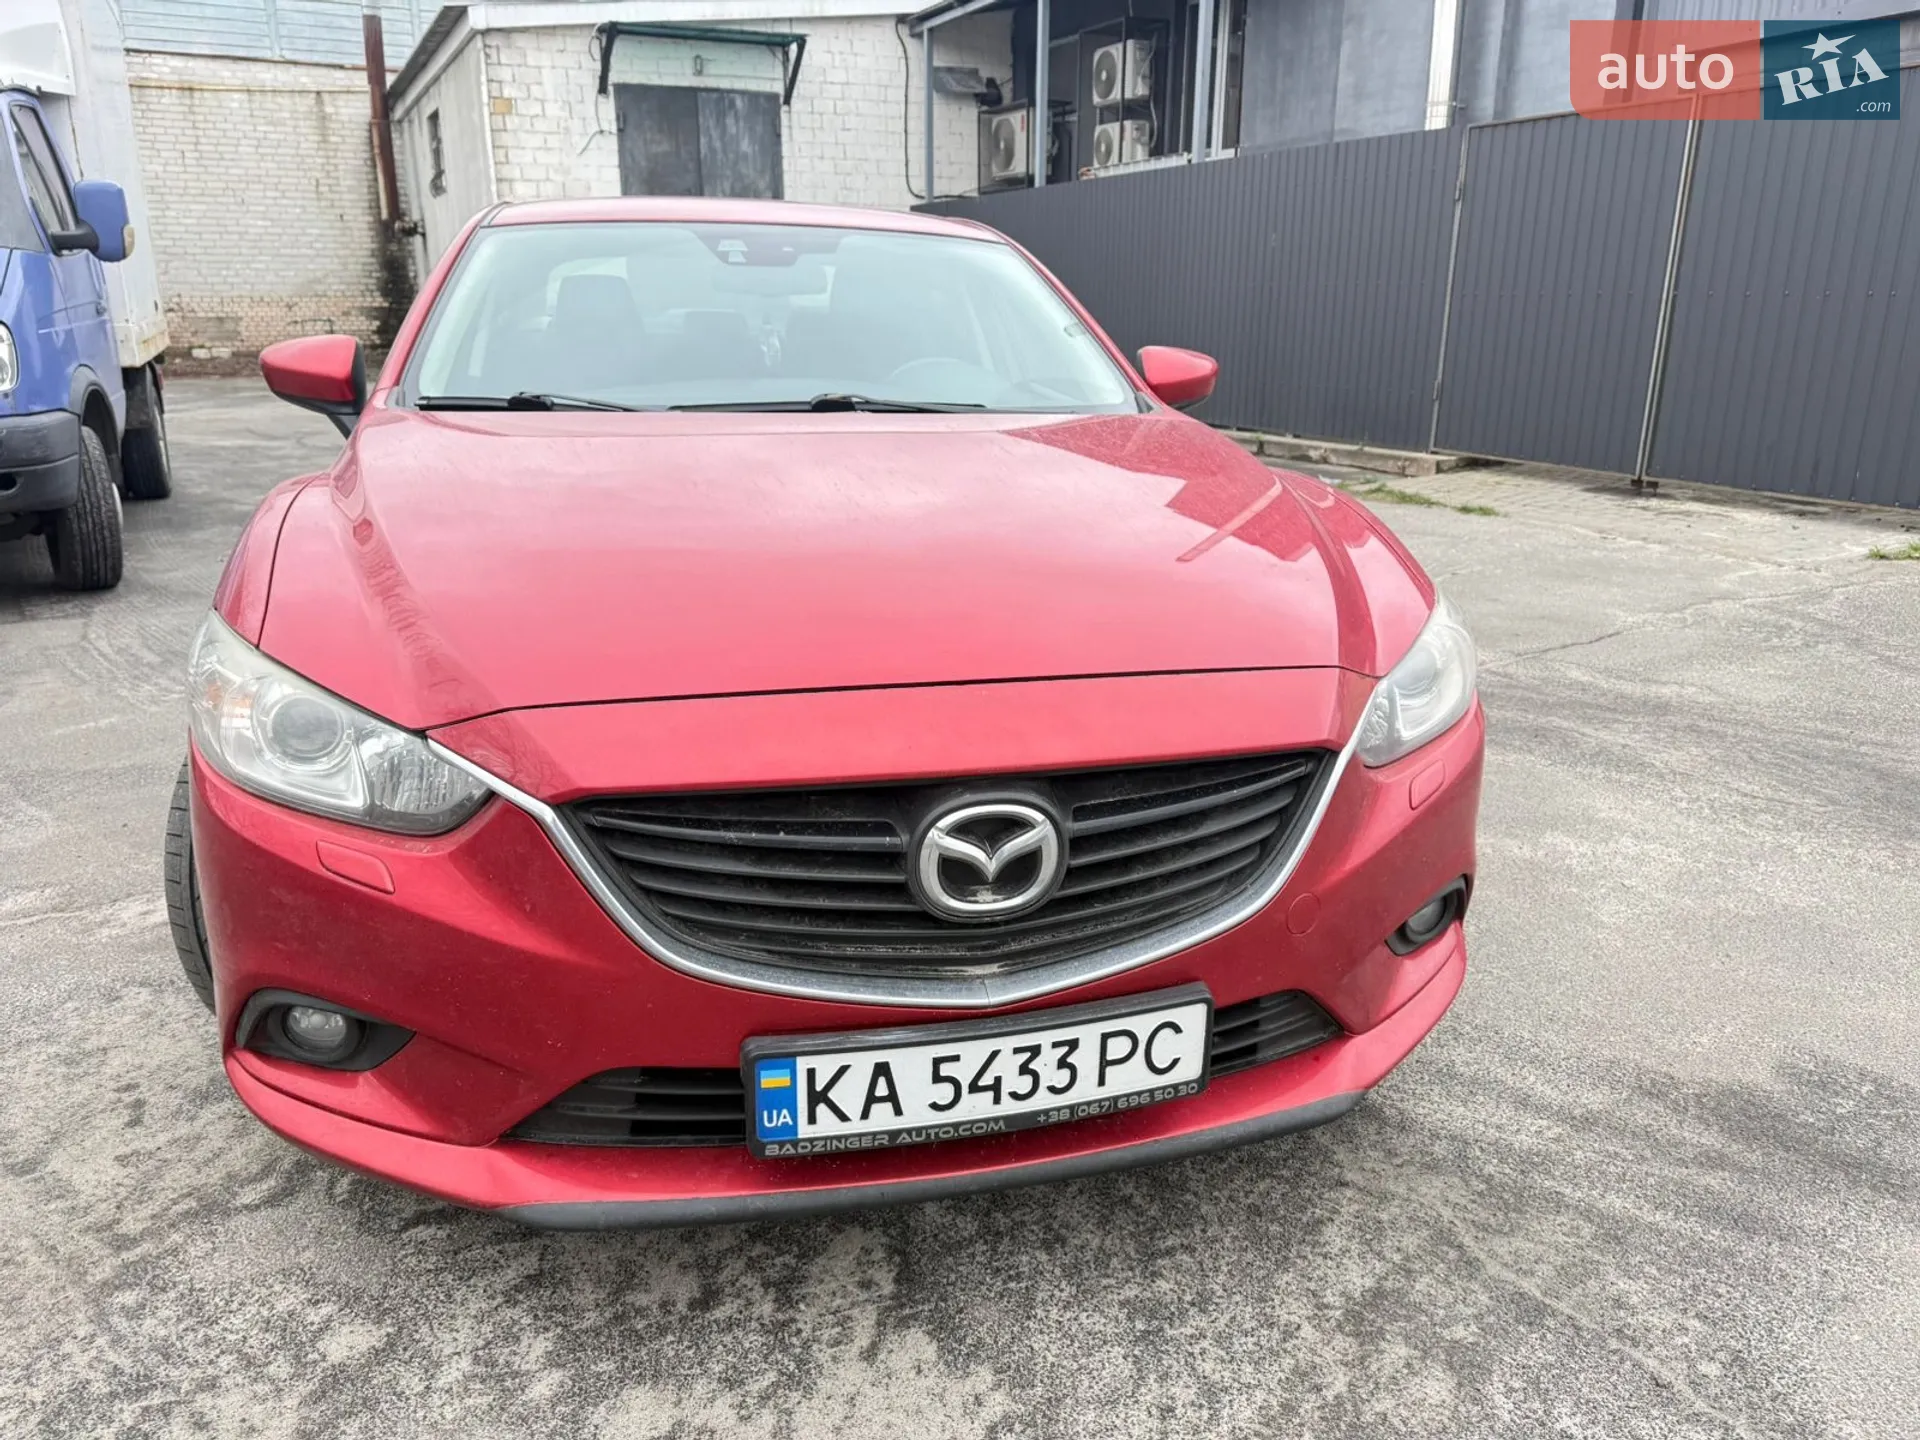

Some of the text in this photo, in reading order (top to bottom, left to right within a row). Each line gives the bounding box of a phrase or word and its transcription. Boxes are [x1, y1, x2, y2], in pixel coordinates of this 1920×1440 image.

[806, 1020, 1184, 1125] KA 5433 PC
[763, 1108, 793, 1128] UA
[1037, 1082, 1198, 1124] +38 (067) 696 50 30
[896, 1119, 1006, 1144] AUTO.COM
